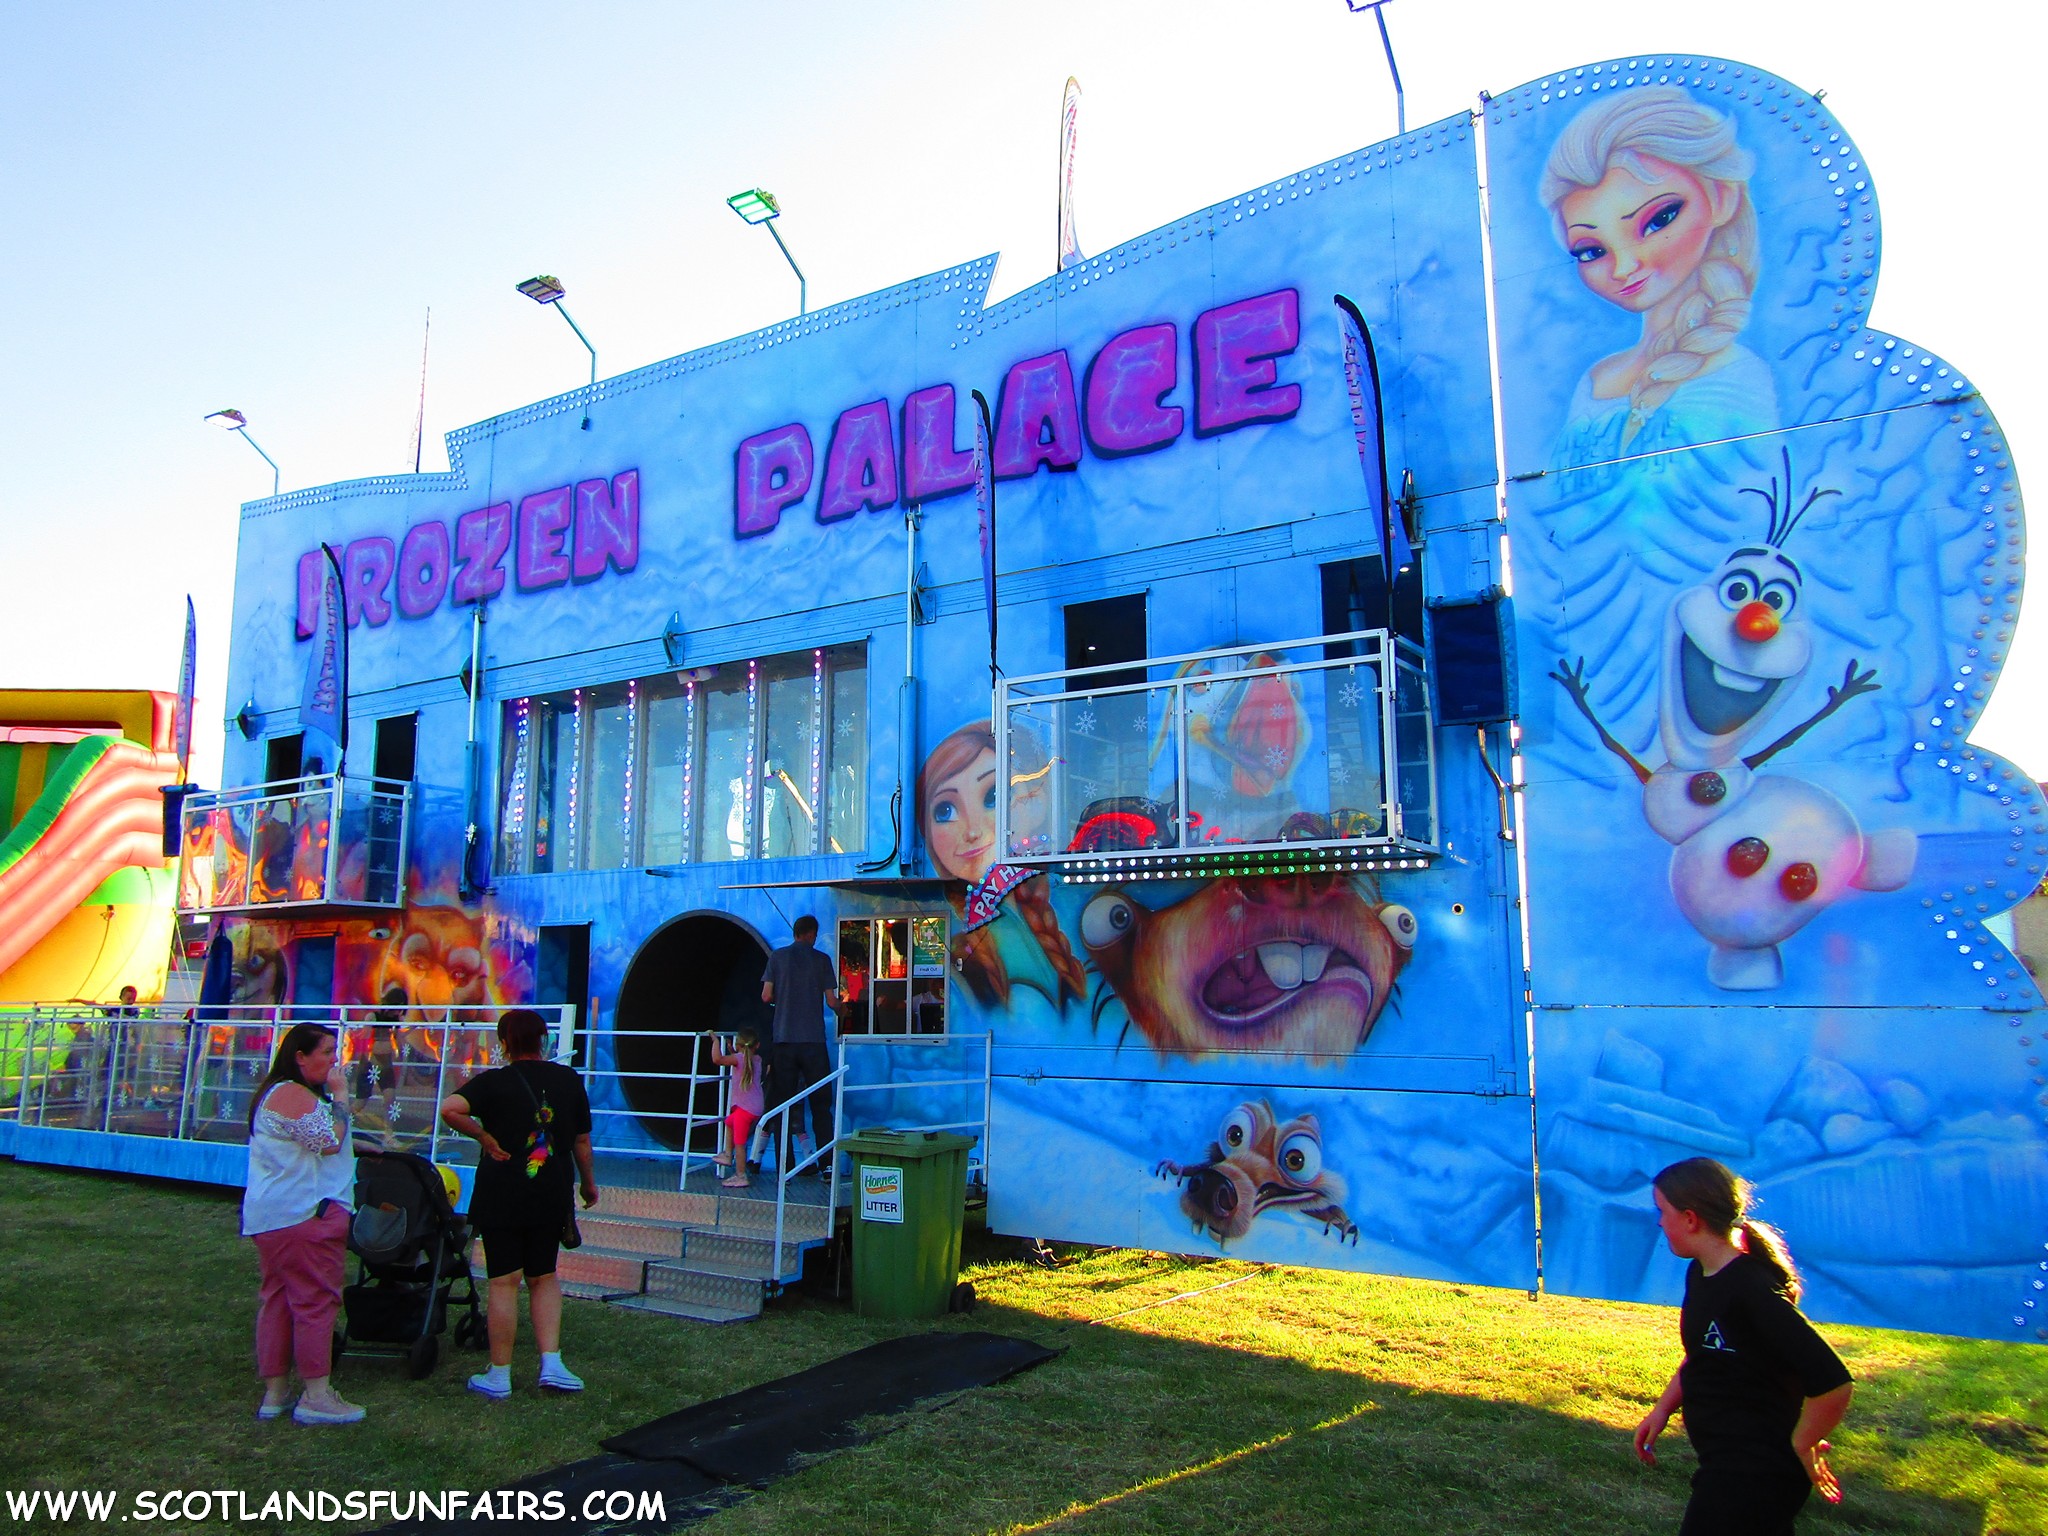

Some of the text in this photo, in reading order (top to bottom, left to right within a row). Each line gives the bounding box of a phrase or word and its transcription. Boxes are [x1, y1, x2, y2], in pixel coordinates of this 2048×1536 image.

[296, 469, 638, 641] FROZEN
[733, 287, 1302, 541] PALACE
[975, 877, 999, 917] PAY
[866, 1200, 898, 1213] LITTER
